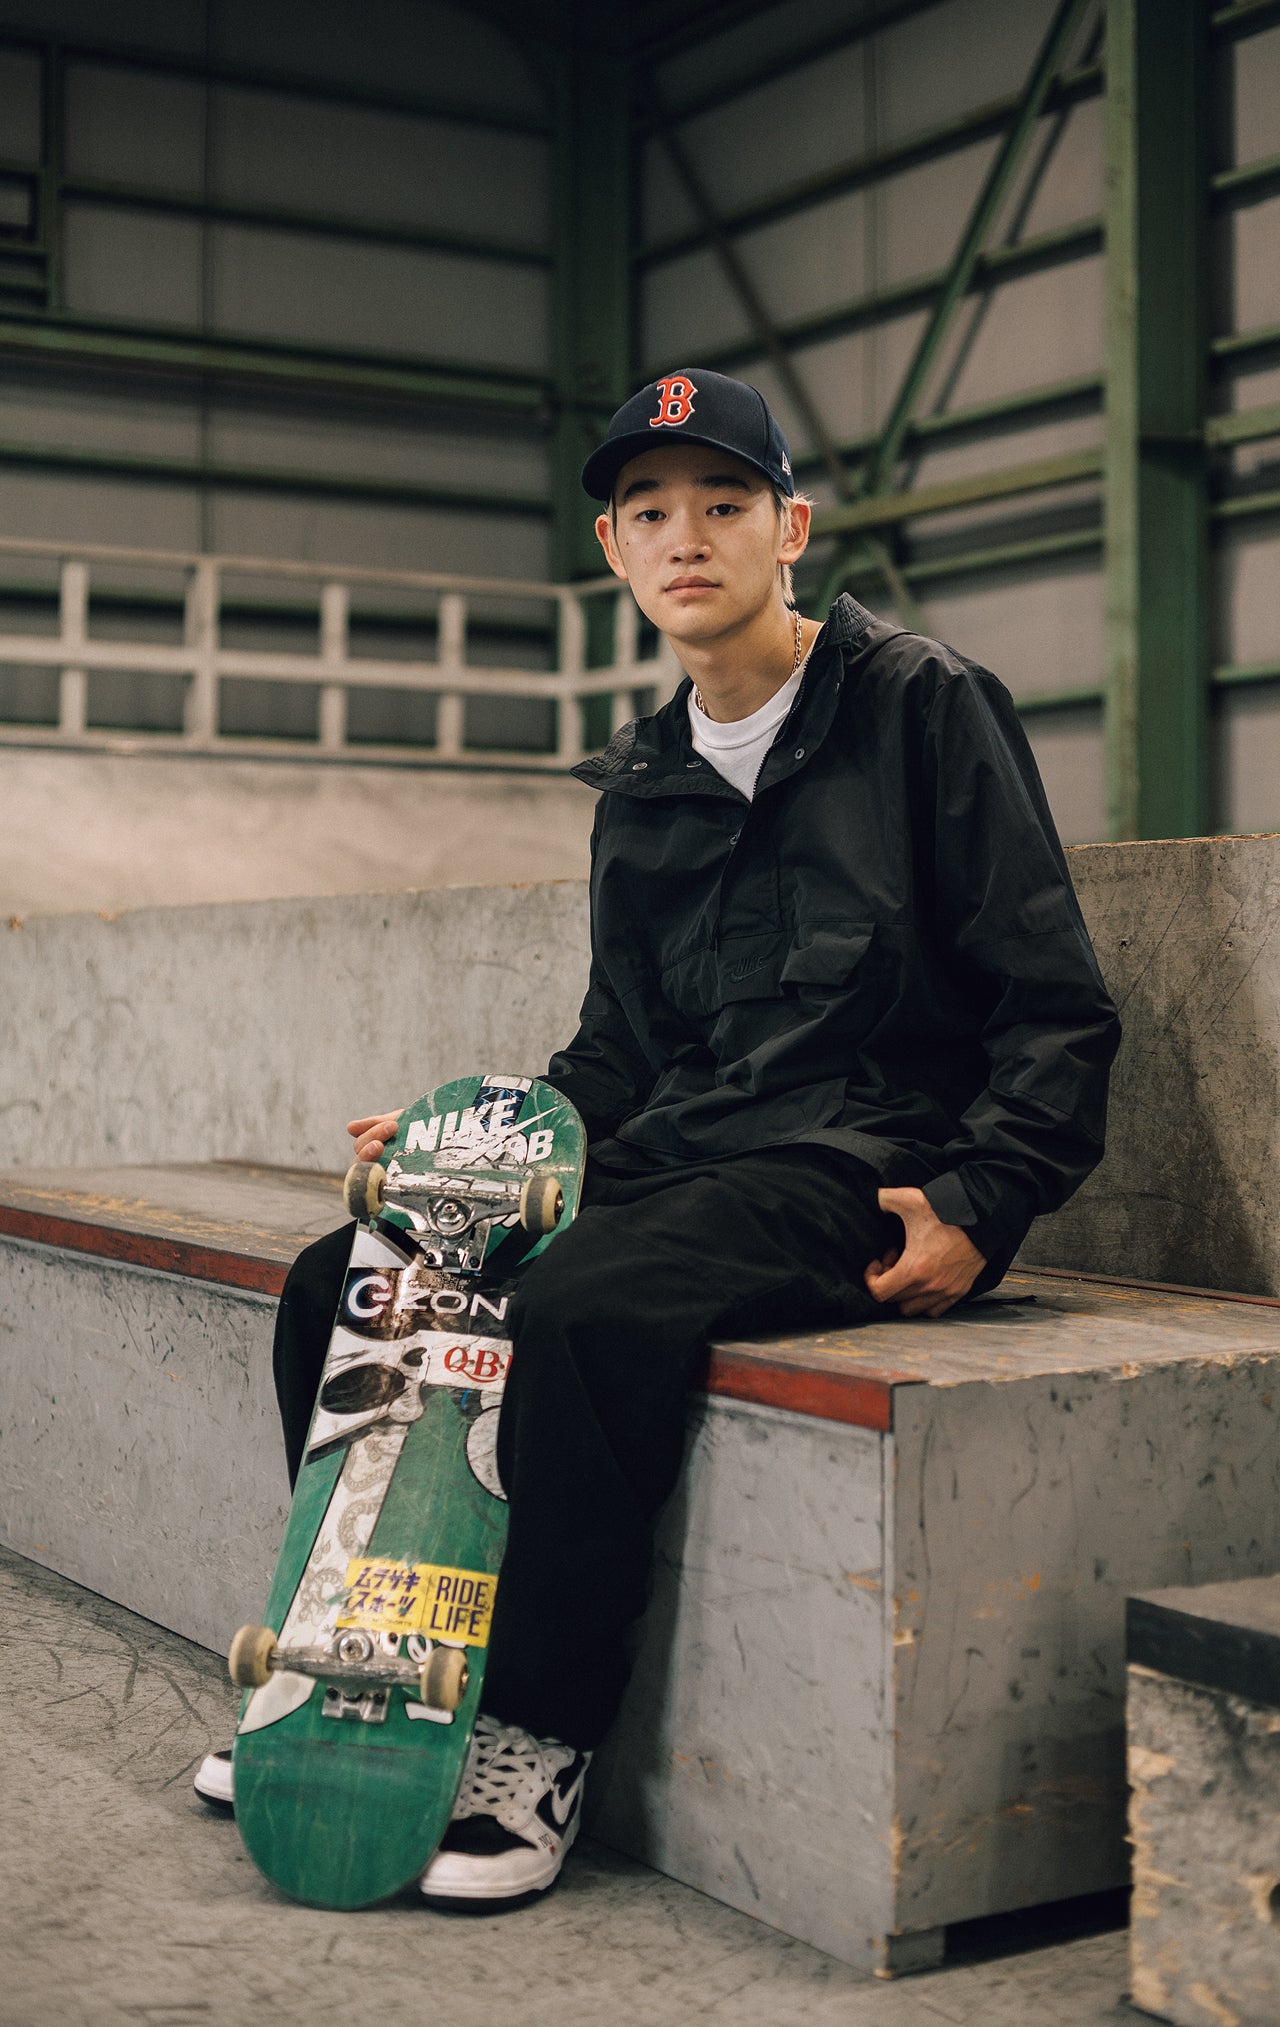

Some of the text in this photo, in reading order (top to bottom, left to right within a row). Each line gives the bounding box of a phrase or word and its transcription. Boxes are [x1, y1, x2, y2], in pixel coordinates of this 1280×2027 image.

[650, 375, 699, 427] B
[404, 1097, 510, 1151] NIKE
[353, 1566, 421, 1593] ムラサキ
[436, 1575, 489, 1608] RIDE
[430, 1603, 484, 1637] LIFE
